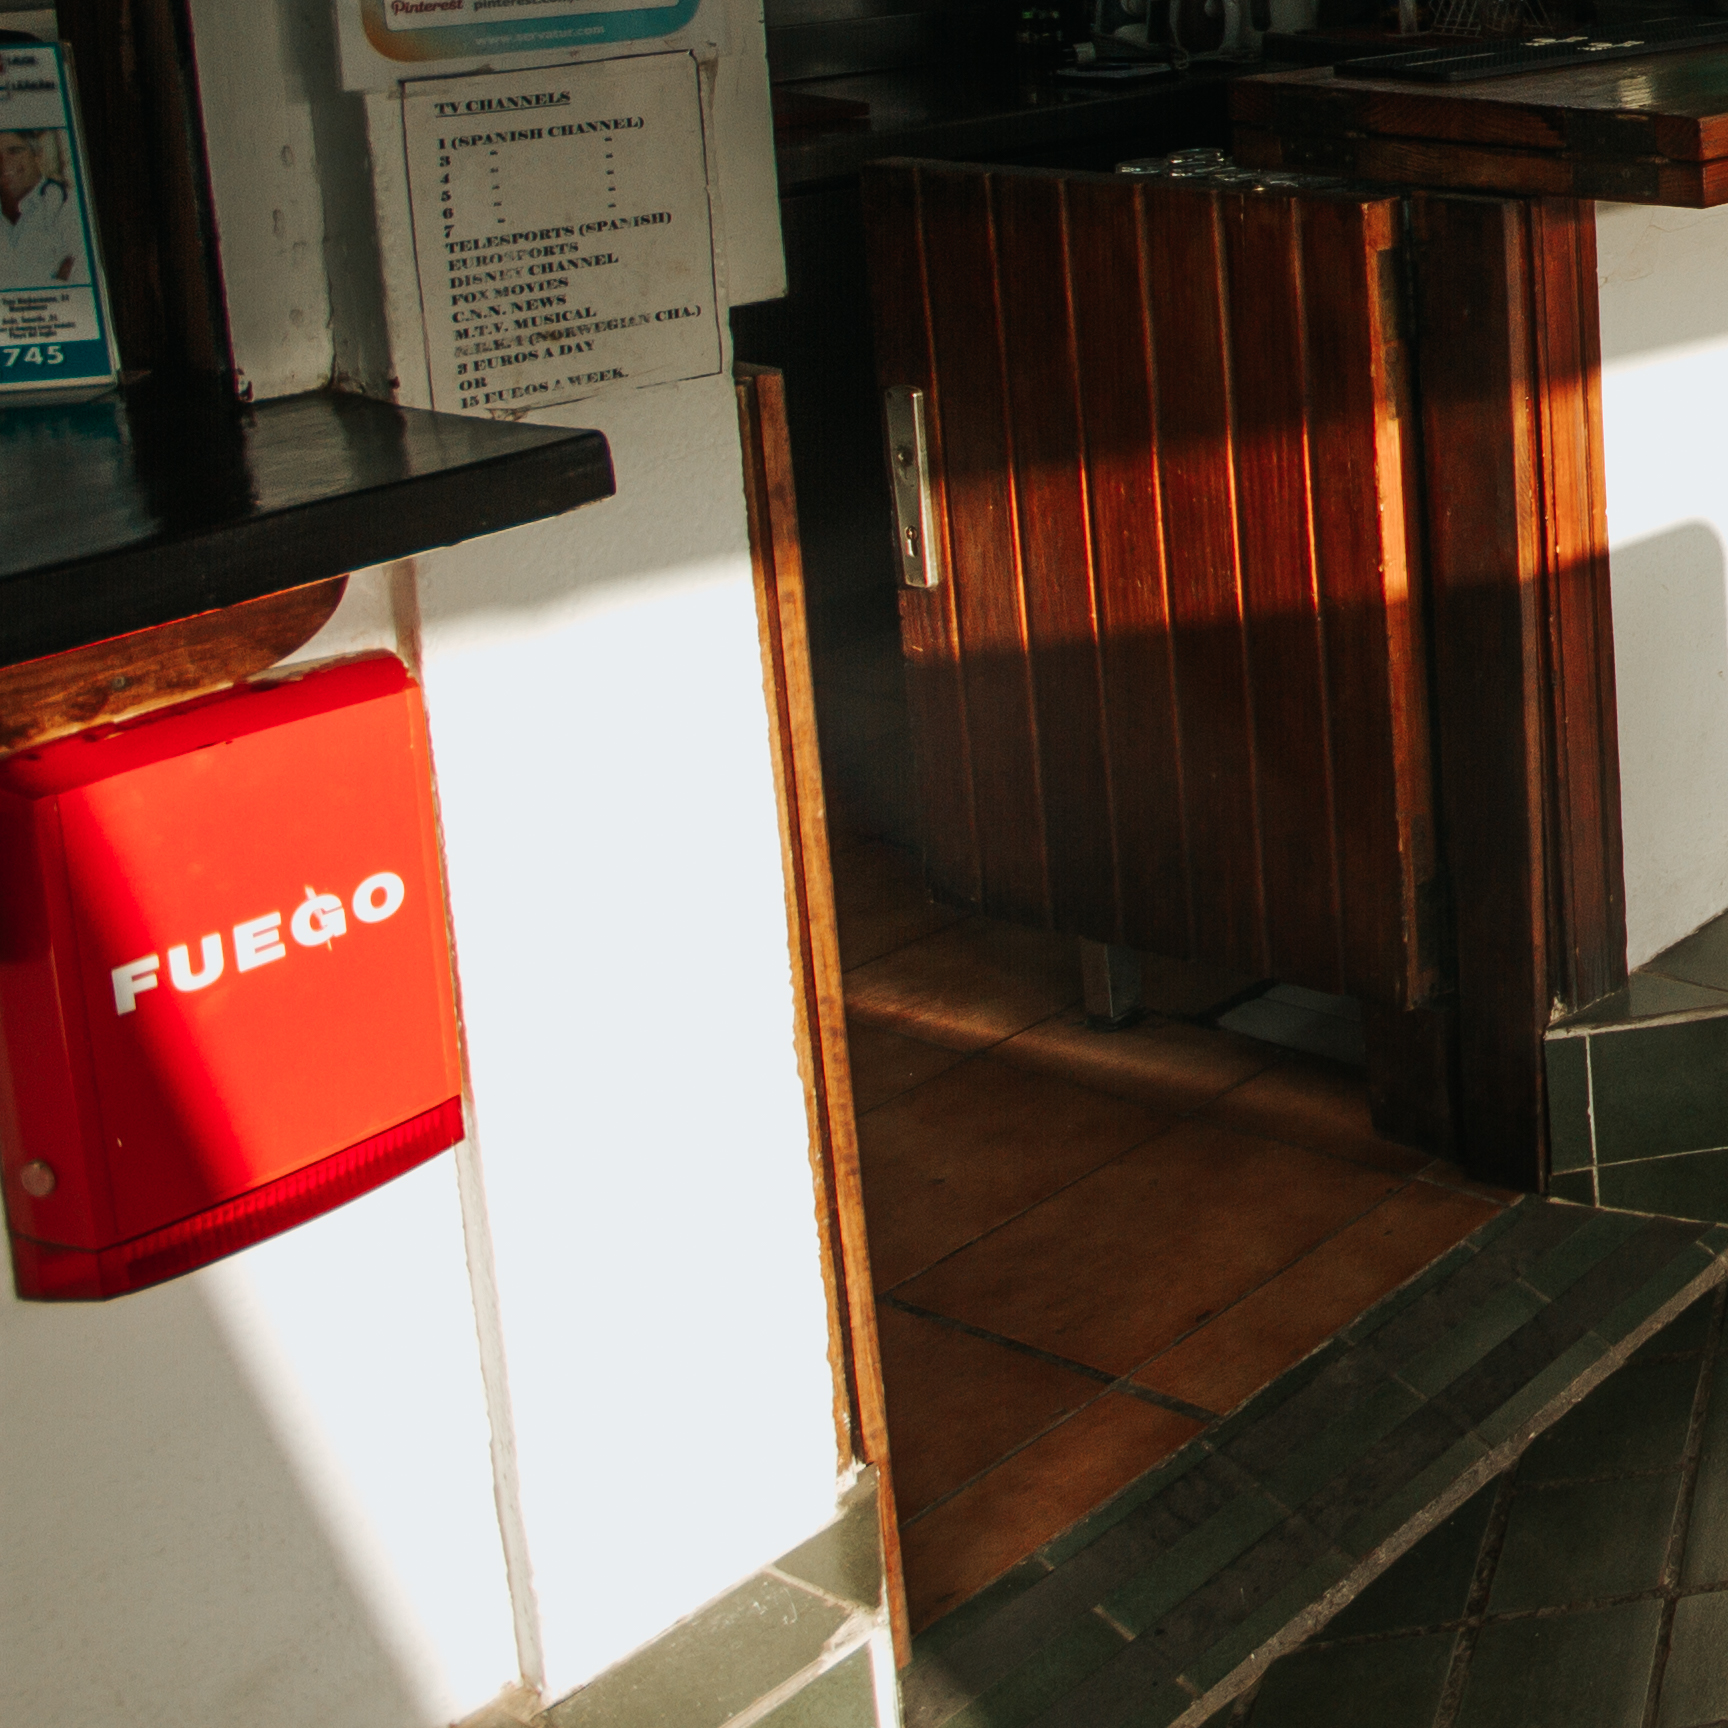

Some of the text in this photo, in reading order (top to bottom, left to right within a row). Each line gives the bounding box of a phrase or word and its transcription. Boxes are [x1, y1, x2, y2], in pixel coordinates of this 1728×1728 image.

[434, 90, 571, 115] TV CHANNELS
[451, 127, 544, 150] (SPANISH
[547, 115, 645, 139] CHANNEL)
[439, 155, 451, 167] 3
[440, 173, 451, 184] 4
[441, 190, 452, 202] 5
[442, 207, 454, 220] 6
[443, 224, 455, 239] 7
[445, 211, 672, 254] TELESPORTS (SPANISH)
[527, 253, 619, 276] CHANNEL
[451, 277, 569, 306] FOX MOVIES
[452, 293, 567, 324] C.N.N. NEWS
[654, 305, 703, 322] CHA.)
[454, 306, 597, 341] M.T.V. MUSICAL
[456, 339, 596, 376] 3 EUROS A DAY
[458, 376, 488, 391] OR
[460, 395, 480, 410] 15
[110, 871, 406, 1017] FUEGO
